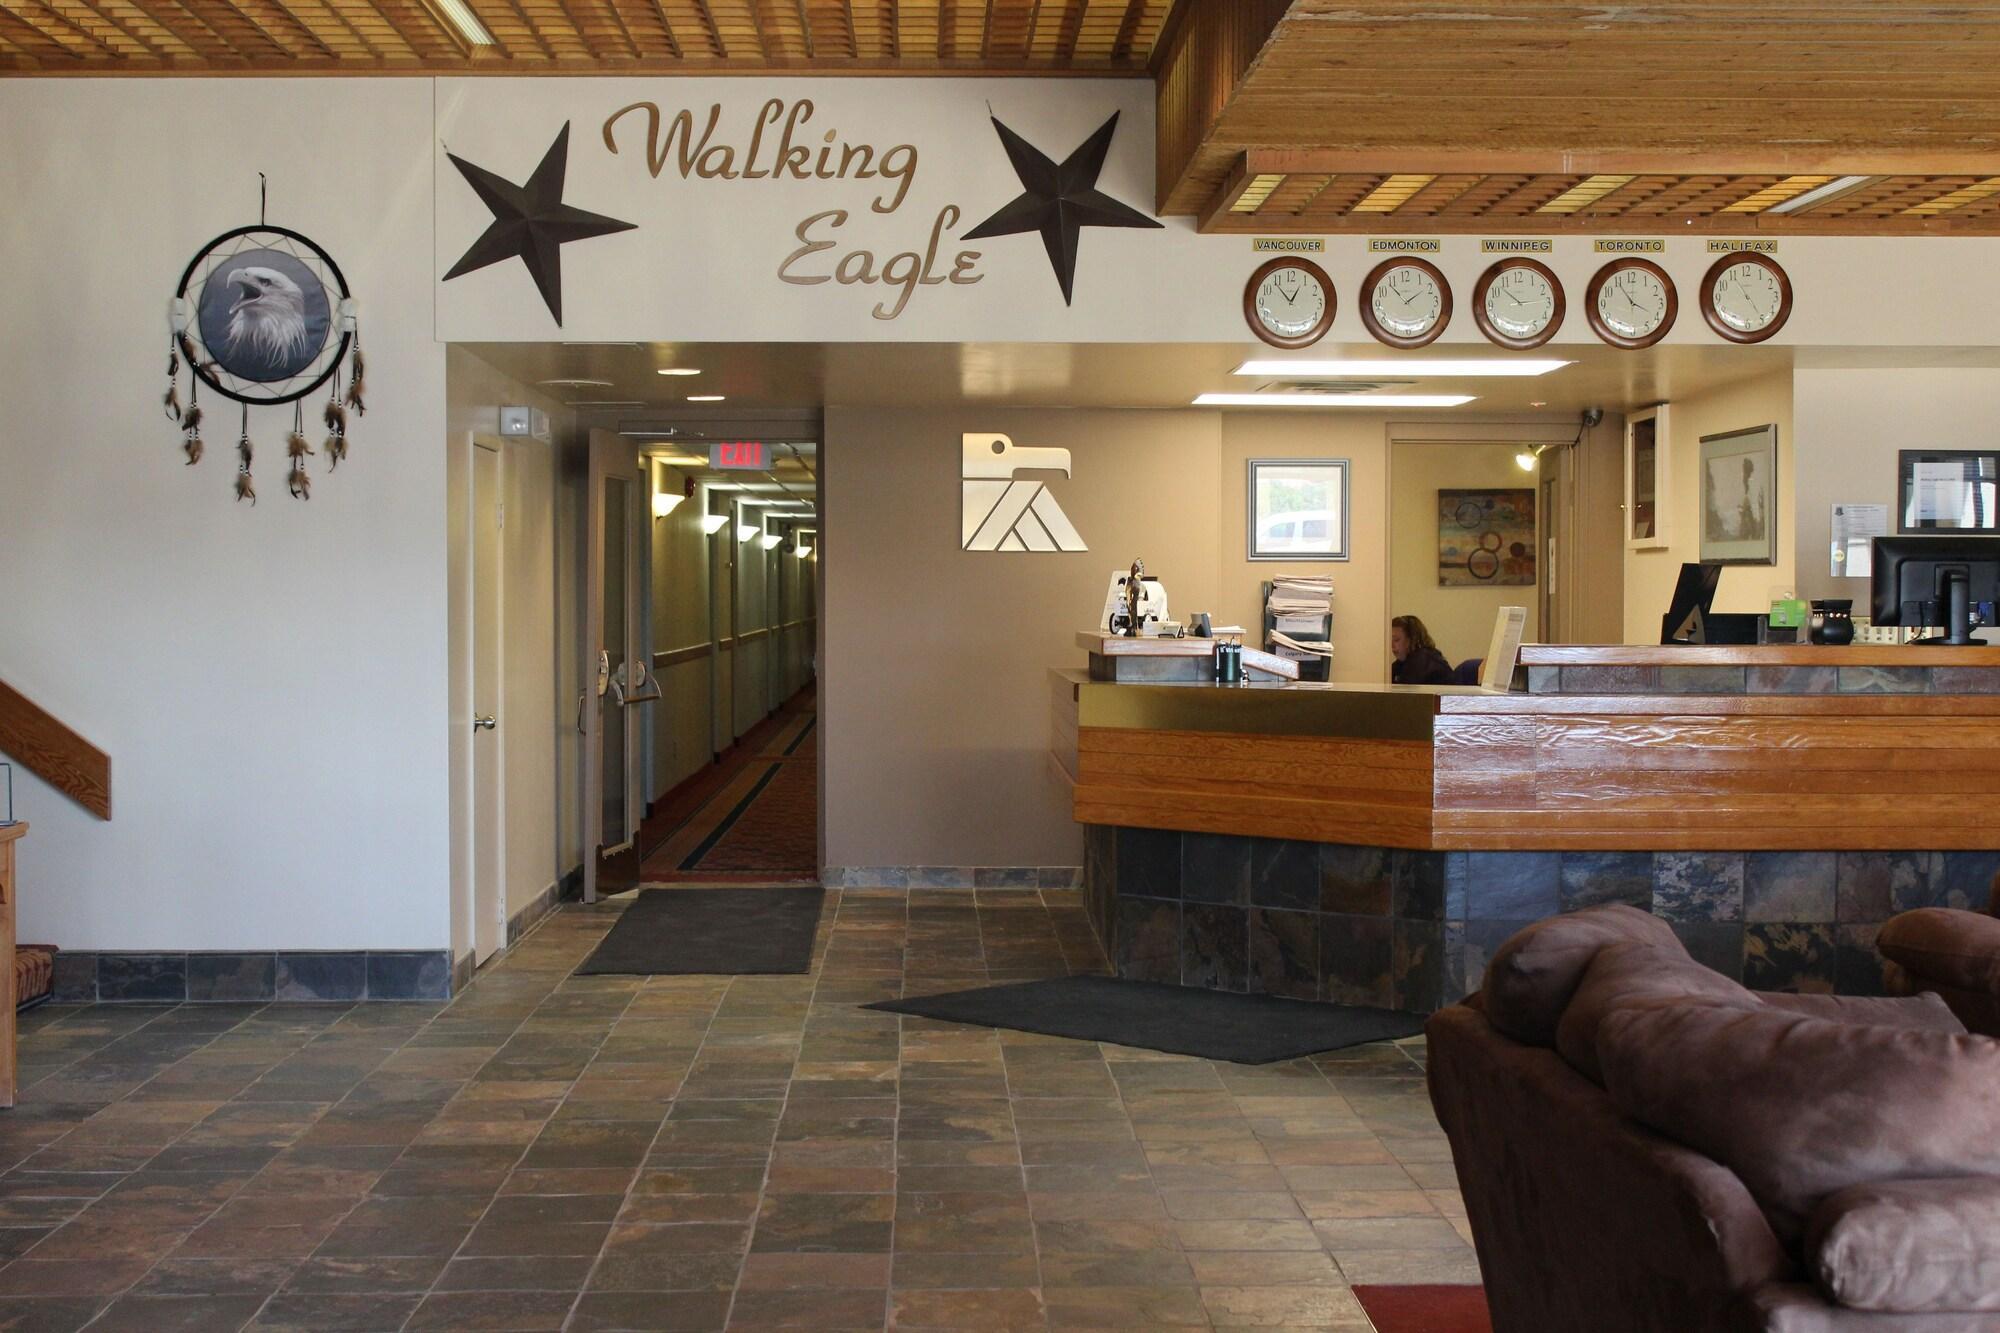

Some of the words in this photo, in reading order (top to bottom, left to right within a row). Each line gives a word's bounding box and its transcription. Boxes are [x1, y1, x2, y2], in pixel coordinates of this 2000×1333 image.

[603, 98, 918, 213] Walking
[1256, 240, 1321, 251] VANCOUVER
[1372, 241, 1437, 250] EDMONTON
[1485, 241, 1549, 250] WINNIPEG
[1599, 241, 1662, 251] TORONTO
[1710, 242, 1773, 250] HALIFAX
[777, 204, 985, 320] Eagle
[1287, 271, 1295, 282] 12
[1401, 271, 1410, 282] 12
[1730, 270, 1737, 280] 11
[1742, 265, 1750, 277] 12
[1274, 275, 1281, 286] 11
[1389, 276, 1396, 287] 11
[1502, 276, 1509, 288] 11
[1514, 271, 1523, 283] 12
[1615, 276, 1622, 287] 11
[1627, 271, 1636, 283] 12
[1263, 284, 1272, 295] 10
[1428, 283, 1433, 295] 2
[1540, 284, 1545, 295] 2
[1719, 280, 1728, 291] 10
[1768, 278, 1773, 290] 2
[1312, 284, 1318, 296] 2
[1379, 286, 1387, 298] 10
[1491, 287, 1500, 298] 10
[1604, 286, 1613, 298] 10
[1653, 284, 1658, 296] 2
[1433, 296, 1438, 307] 3
[1546, 297, 1551, 308] 3
[1773, 291, 1778, 303] 3
[1317, 298, 1322, 310] 3
[1658, 297, 1664, 310] 3
